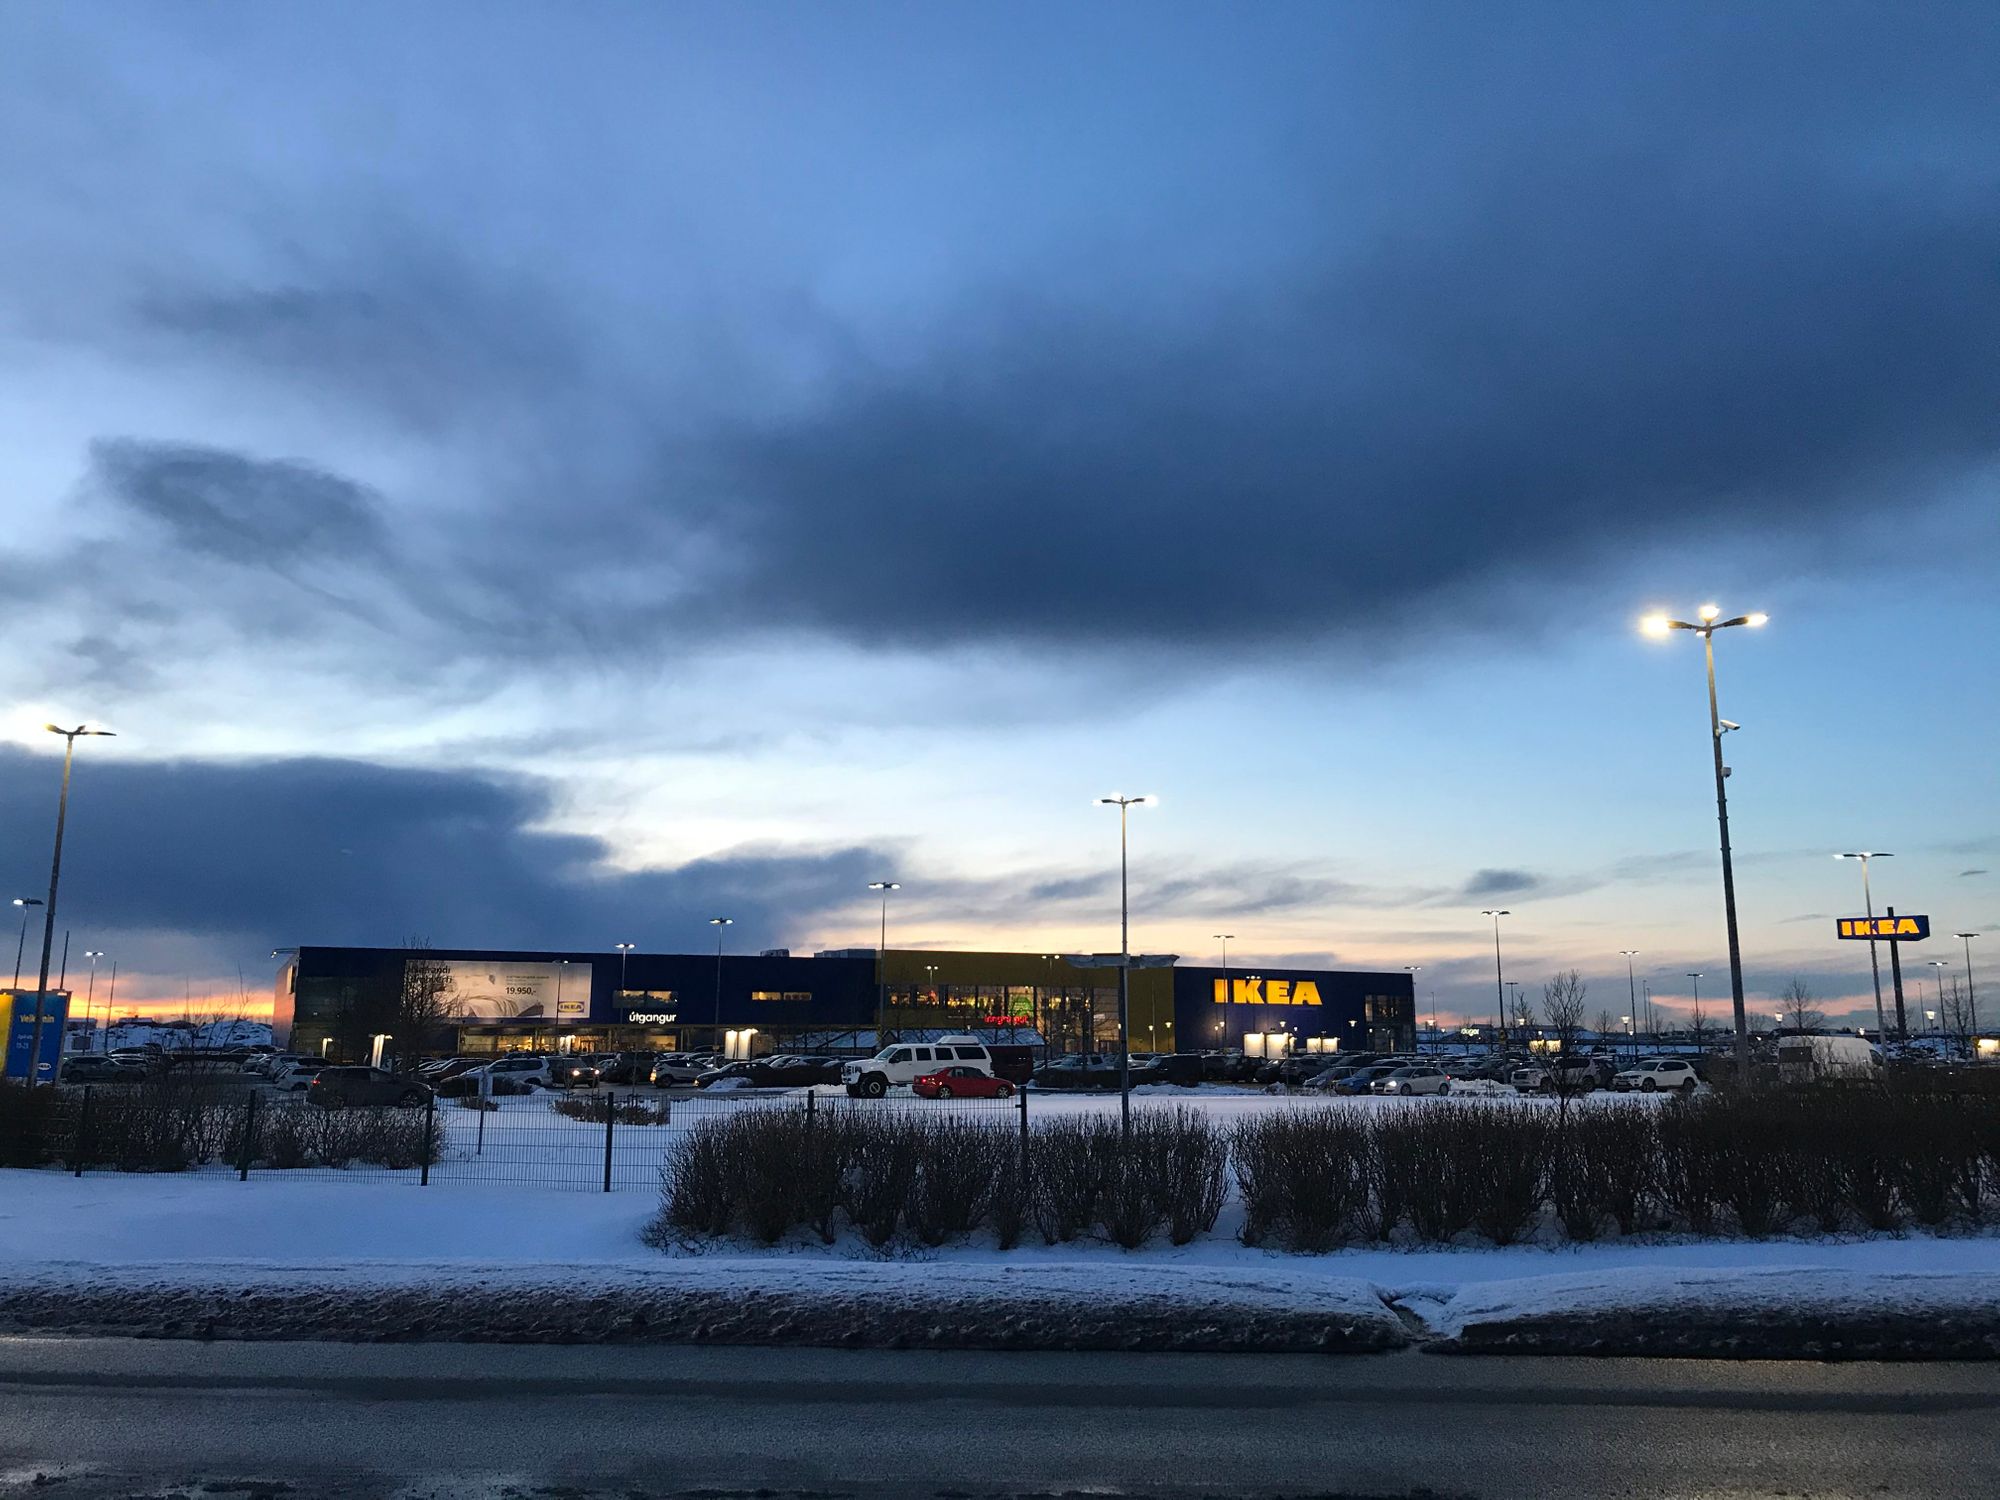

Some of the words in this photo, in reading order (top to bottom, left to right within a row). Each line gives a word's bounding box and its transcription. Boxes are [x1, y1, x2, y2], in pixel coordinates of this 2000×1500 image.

[1841, 918, 1920, 936] IKEA
[505, 986, 537, 995] 19.950,-
[1214, 978, 1322, 1006] IKEA
[628, 1011, 677, 1025] útgangur
